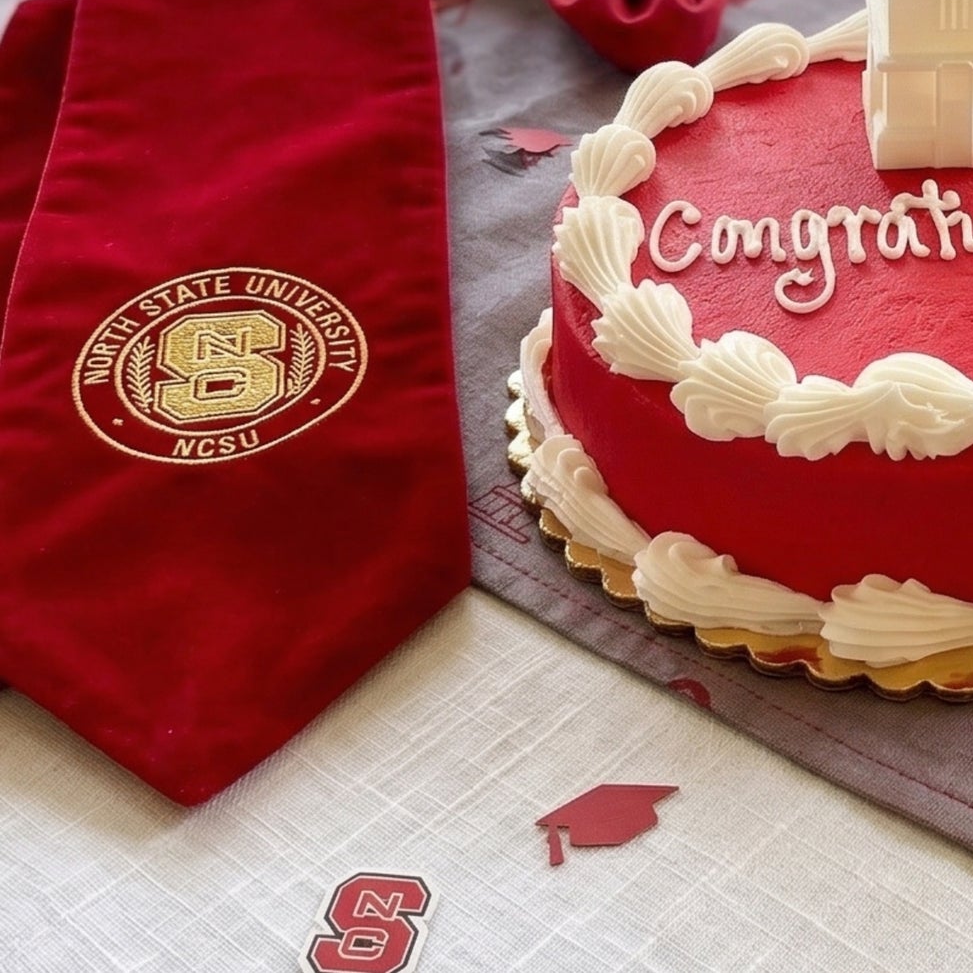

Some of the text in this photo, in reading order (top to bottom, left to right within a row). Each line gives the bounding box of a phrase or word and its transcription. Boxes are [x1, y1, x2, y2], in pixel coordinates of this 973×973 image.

[83, 274, 358, 385] NORTH STATE UNIVERSITY
[172, 429, 261, 458] NCSU
